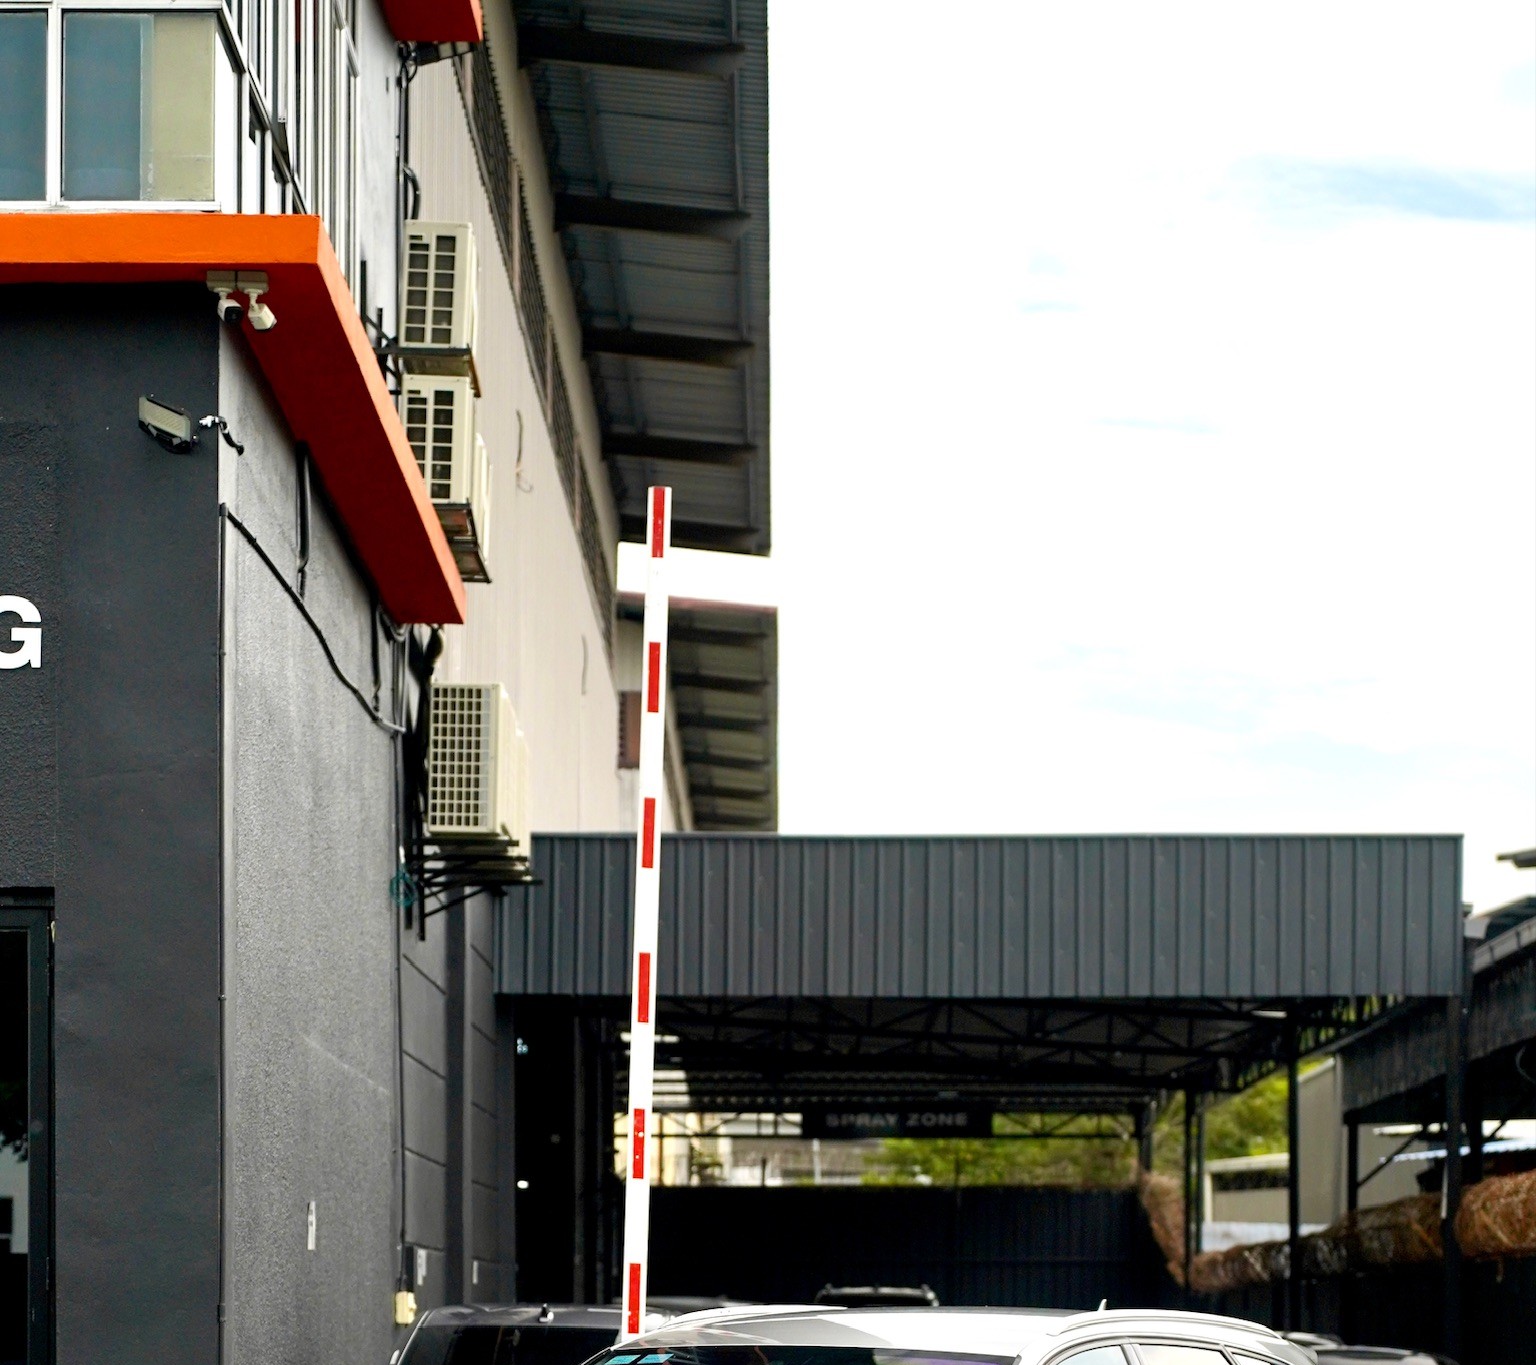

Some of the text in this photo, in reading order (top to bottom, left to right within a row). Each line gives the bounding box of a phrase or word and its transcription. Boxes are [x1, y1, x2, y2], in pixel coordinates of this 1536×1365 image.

[0, 594, 42, 669] G
[826, 1112, 968, 1127] SPRAY ZONE
